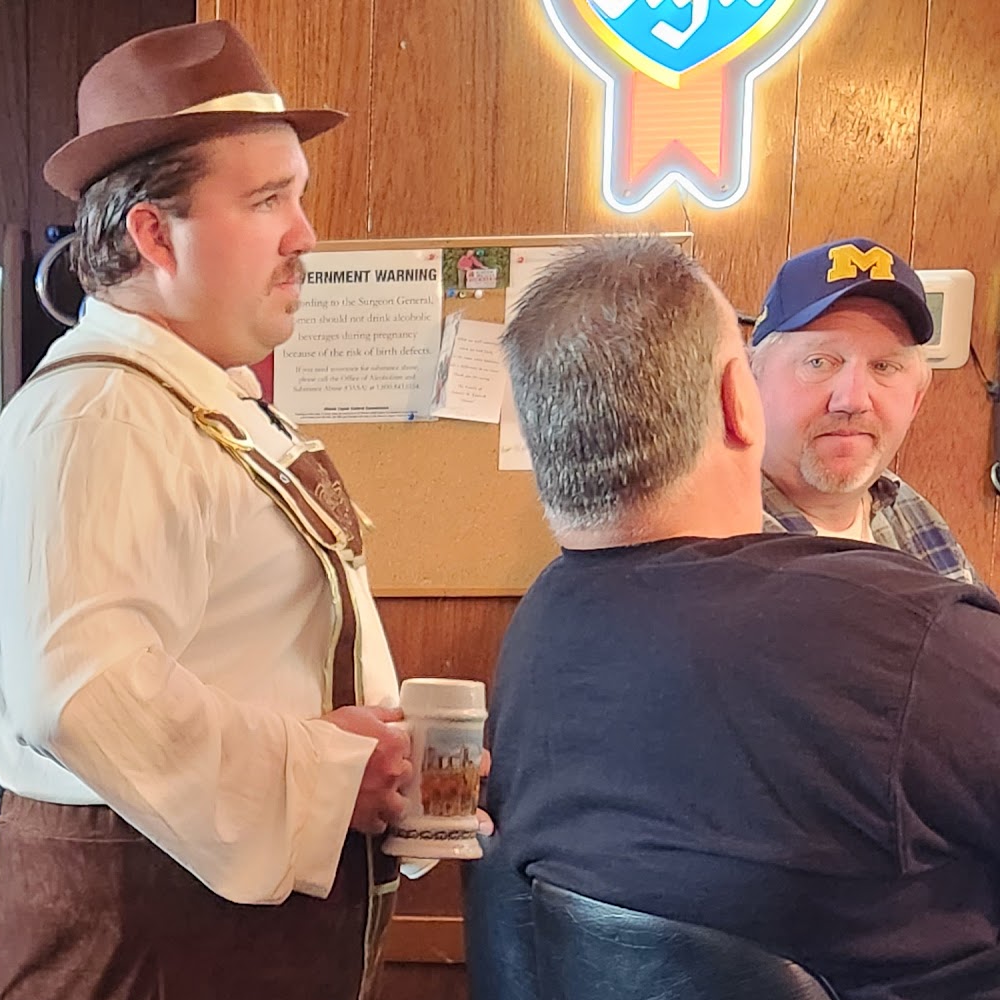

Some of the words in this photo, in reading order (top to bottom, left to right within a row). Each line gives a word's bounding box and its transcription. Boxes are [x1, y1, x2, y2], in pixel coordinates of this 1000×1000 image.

[827, 243, 896, 283] M
[375, 268, 437, 282] WARNING
[342, 297, 356, 306] the
[358, 297, 394, 308] Surgeon
[396, 296, 434, 306] General,
[319, 314, 348, 323] should
[350, 315, 365, 323] not
[367, 313, 391, 323] drink
[392, 312, 432, 322] alcoholic
[298, 332, 340, 342] beverages
[341, 331, 371, 341] during
[373, 331, 418, 341] pregnancy
[283, 349, 316, 358] because
[318, 348, 329, 357] of
[330, 347, 344, 357] the
[346, 347, 362, 357] risk
[363, 346, 374, 356] of
[375, 346, 397, 356] birth
